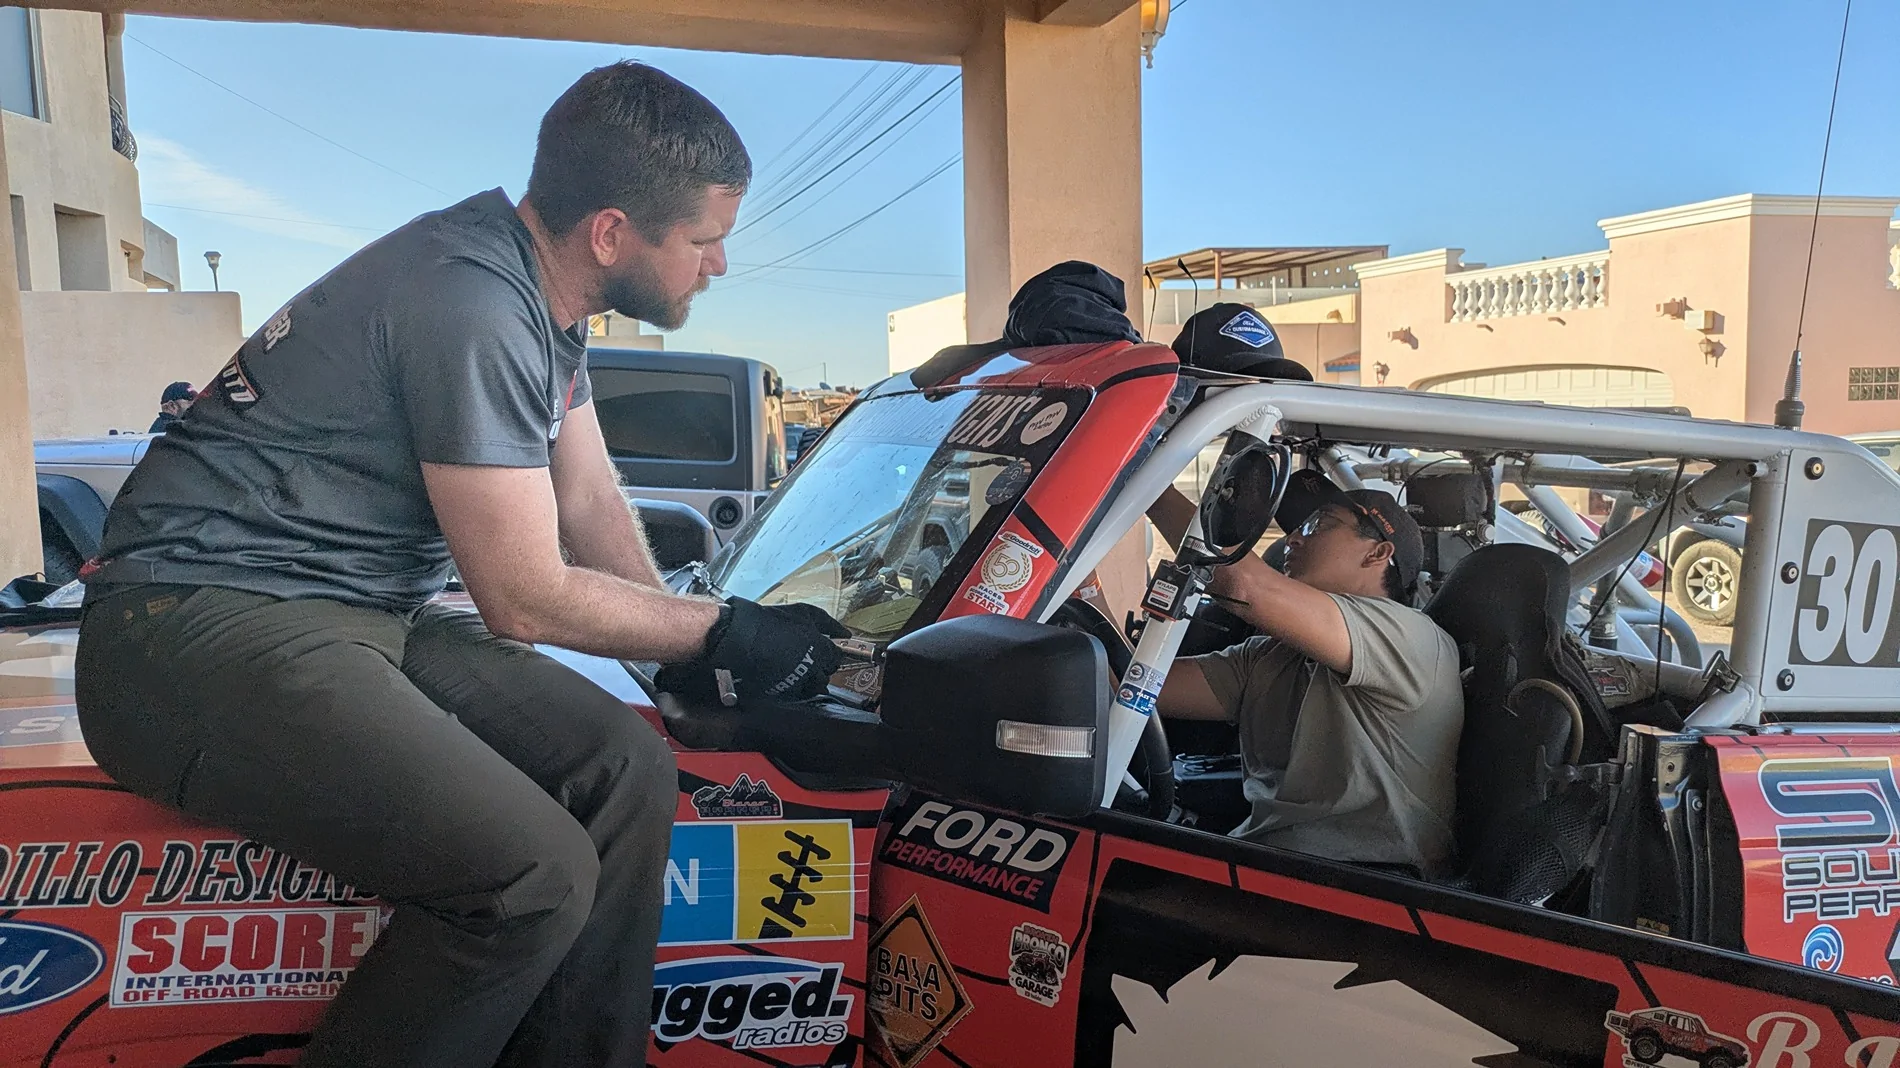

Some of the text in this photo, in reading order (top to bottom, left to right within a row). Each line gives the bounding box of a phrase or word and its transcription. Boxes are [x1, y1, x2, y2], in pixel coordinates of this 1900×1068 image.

[968, 593, 1002, 614] START
[979, 585, 1002, 600] RACES
[899, 800, 1067, 872] FORD
[886, 839, 1044, 900] PERFORMANCE
[1782, 850, 1900, 890] SOU
[126, 912, 367, 974] SCORE
[1011, 931, 1066, 968] BRONCO
[123, 985, 256, 1003] OFF-ROAD
[877, 976, 938, 1021] PITS
[1015, 976, 1055, 1000] GARAGE
[739, 1021, 846, 1047] radios
